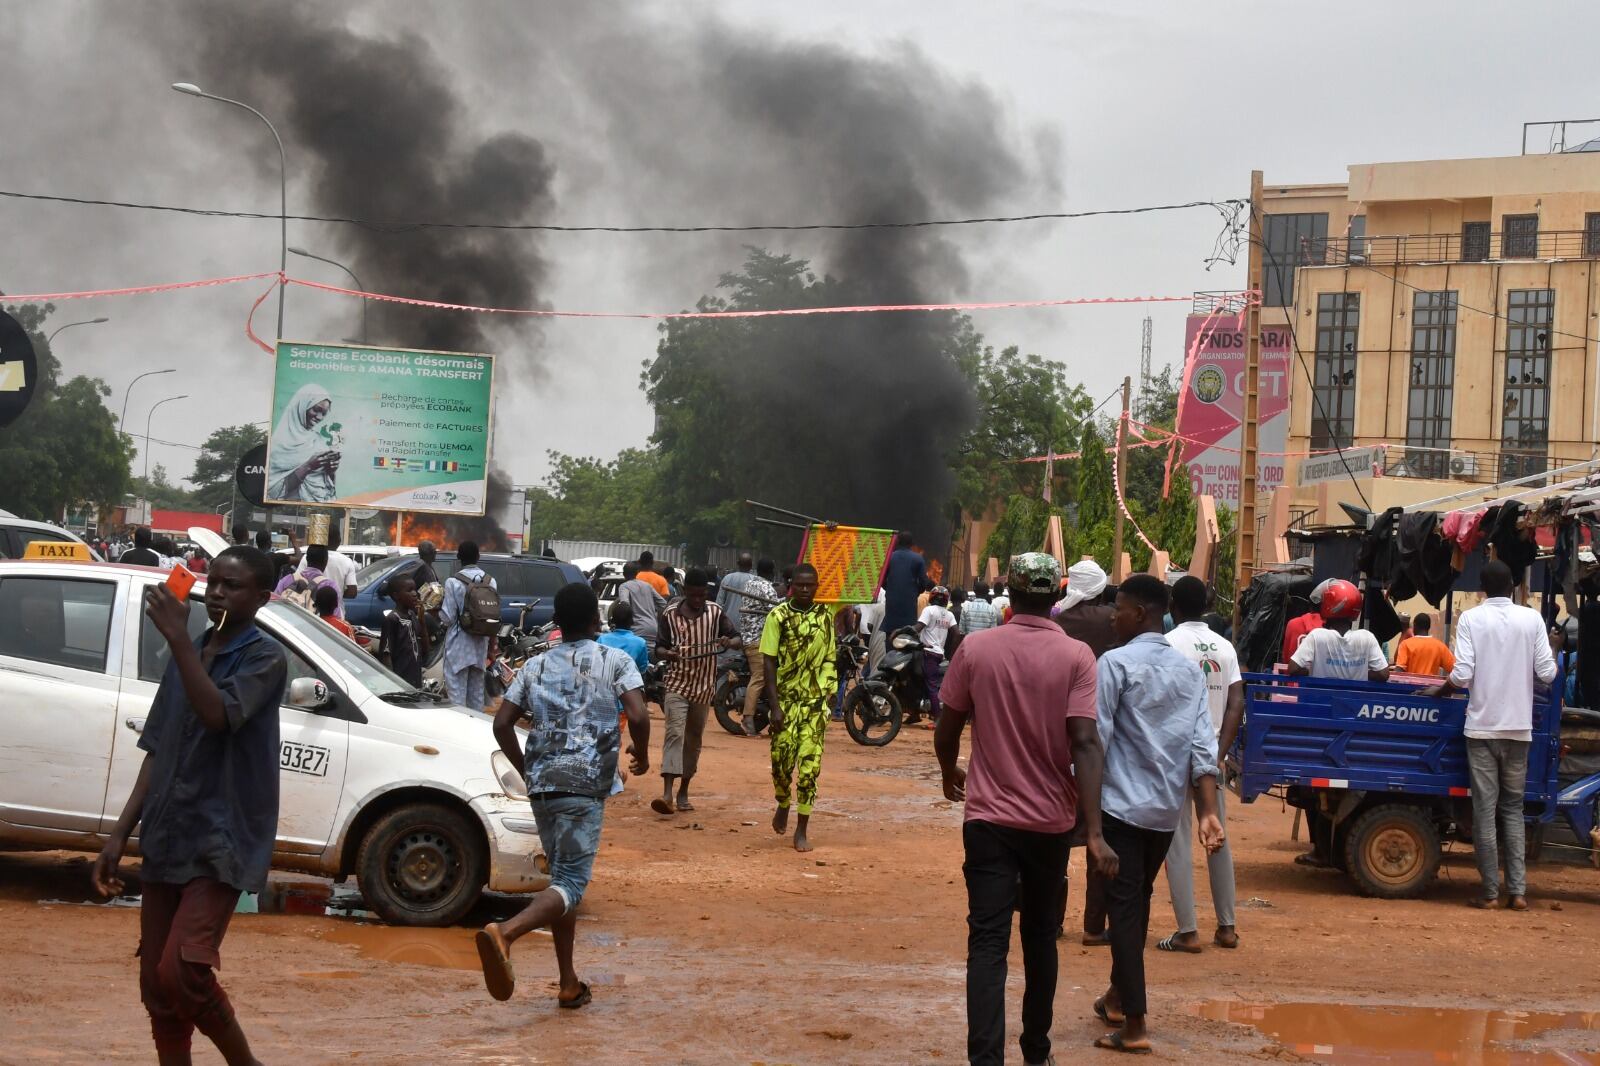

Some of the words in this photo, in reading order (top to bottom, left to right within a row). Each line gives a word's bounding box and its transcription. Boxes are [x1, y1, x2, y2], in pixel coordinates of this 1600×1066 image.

[290, 347, 348, 360] Services
[351, 351, 410, 365] Ecobank
[414, 355, 485, 370] désormais
[289, 359, 356, 372] disponibles
[358, 364, 365, 373] à
[367, 365, 413, 376] AMANA
[416, 368, 484, 380] TRANSFERT
[380, 401, 425, 411] prépayées
[427, 403, 472, 413] ECOBANK
[424, 396, 436, 404] de
[438, 397, 464, 406] cartes
[379, 419, 421, 429] Paiement
[422, 422, 435, 430] de
[436, 423, 483, 433] FACTURES
[377, 446, 390, 454] via
[378, 438, 416, 448] Transfert
[418, 440, 437, 449] hors
[440, 442, 474, 452] UEMOA
[38, 545, 75, 557] TAXI
[1356, 703, 1440, 723] APSONIC
[281, 745, 326, 772] 9327
